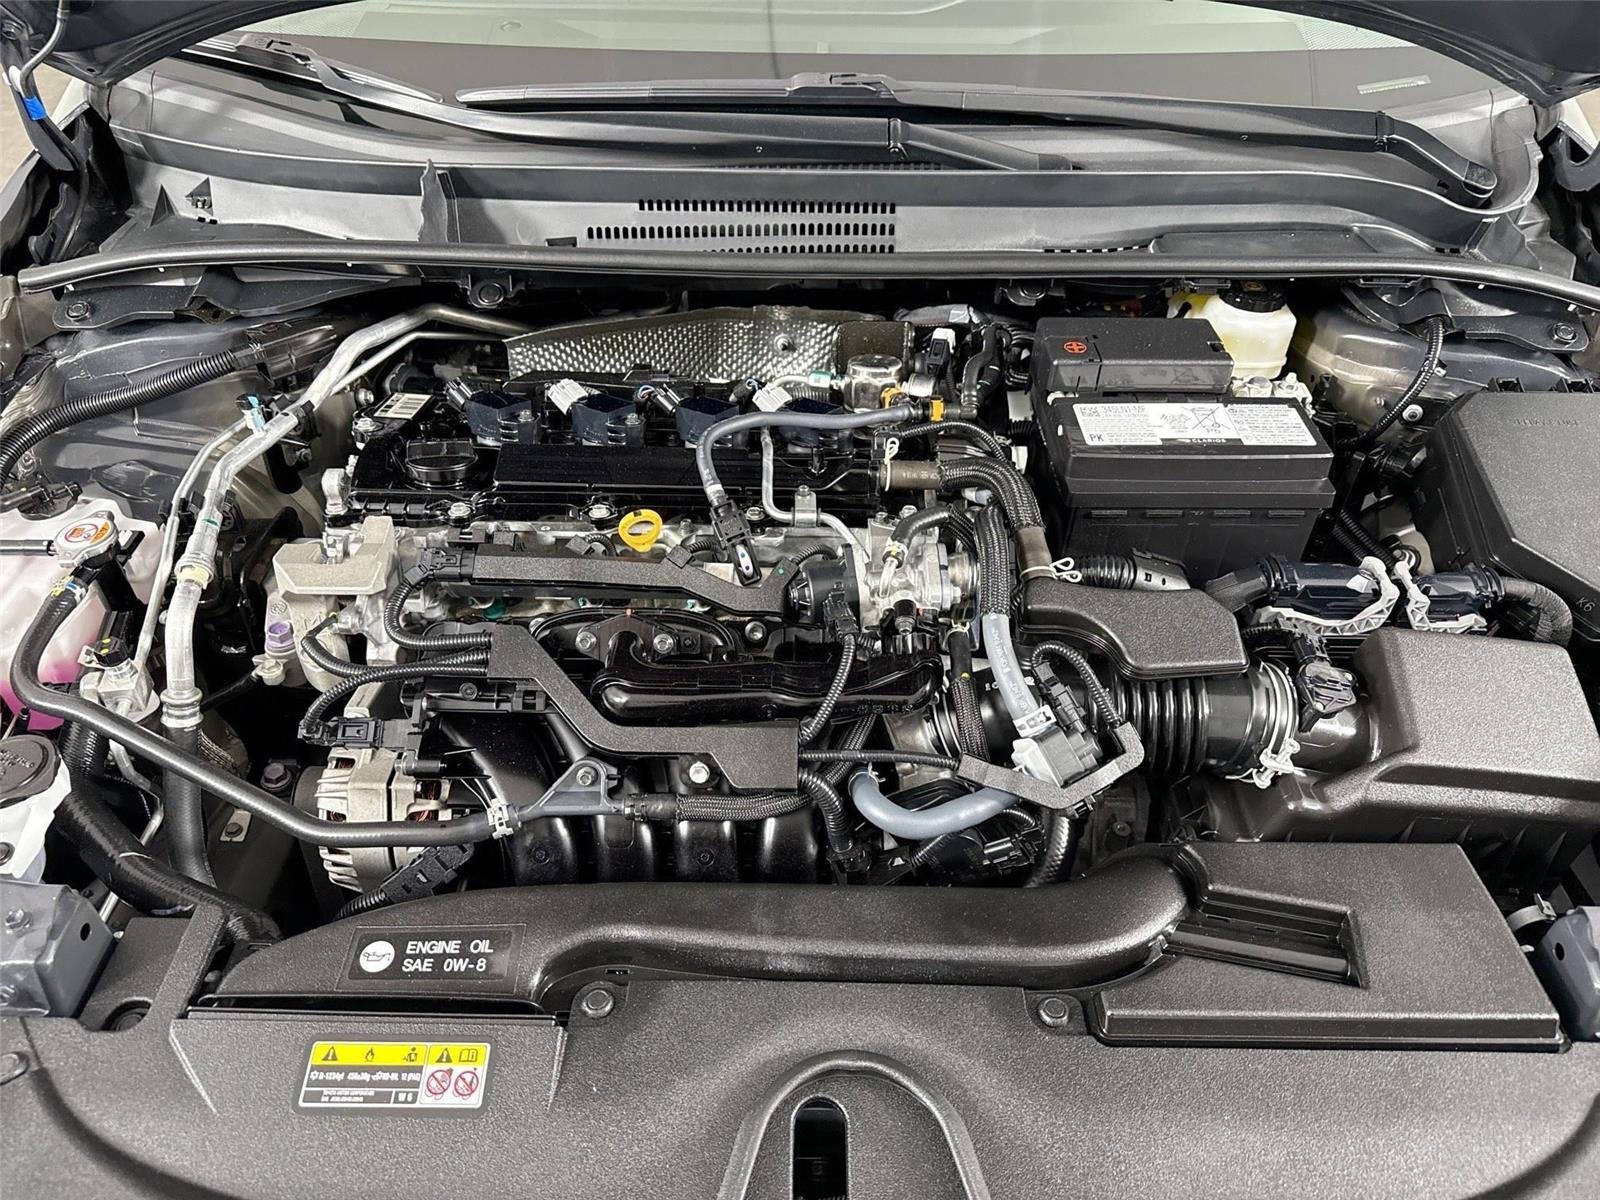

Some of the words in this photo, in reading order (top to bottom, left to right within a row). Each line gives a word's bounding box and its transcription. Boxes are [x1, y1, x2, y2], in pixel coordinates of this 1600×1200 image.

[1089, 433, 1105, 442] PK
[1576, 596, 1596, 612] K6
[405, 940, 462, 954] ENGINE
[469, 939, 494, 953] OIL
[401, 958, 433, 972] SAE
[443, 957, 487, 972] 0W-8
